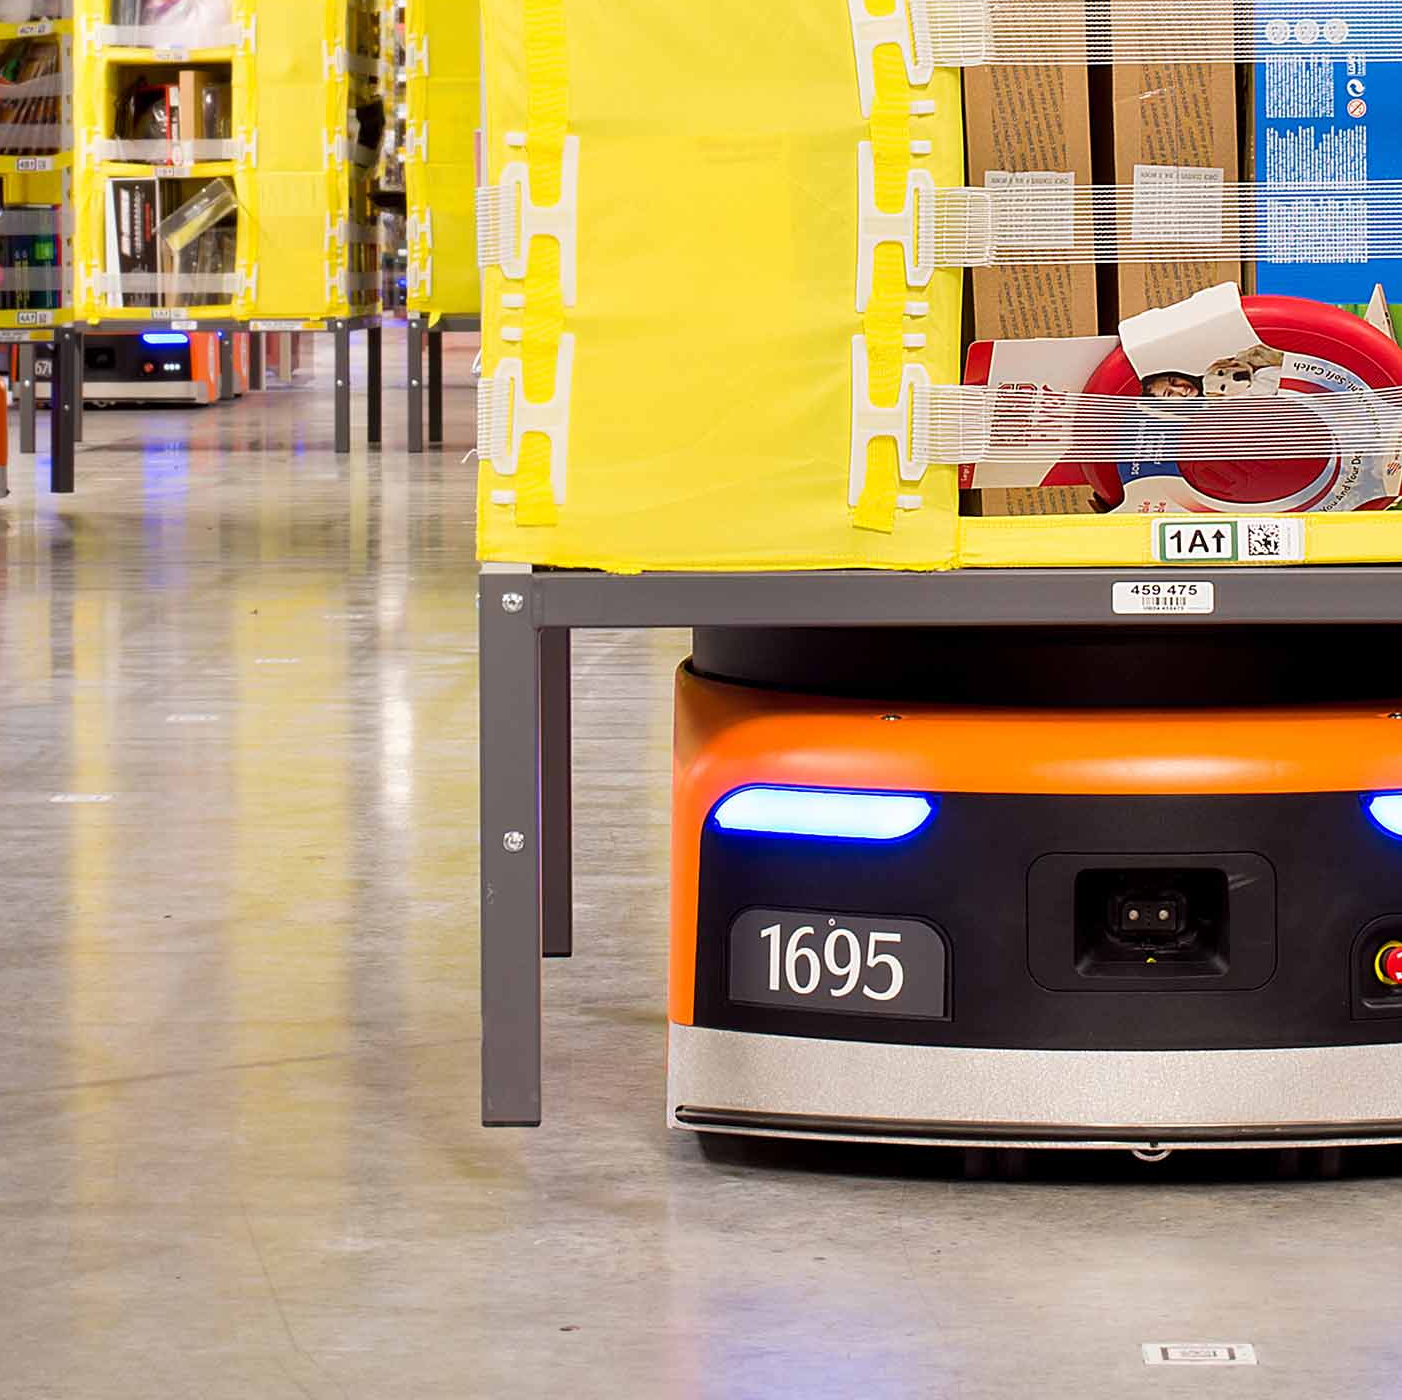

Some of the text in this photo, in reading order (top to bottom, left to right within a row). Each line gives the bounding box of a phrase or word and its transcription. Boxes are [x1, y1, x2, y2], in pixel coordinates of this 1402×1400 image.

[1293, 361, 1346, 385] Soft Catch
[1335, 484, 1351, 501] And
[1346, 466, 1359, 485] Your
[1170, 530, 1209, 553] 1A
[1131, 584, 1198, 595] 459 475
[760, 923, 905, 1001] 1695
